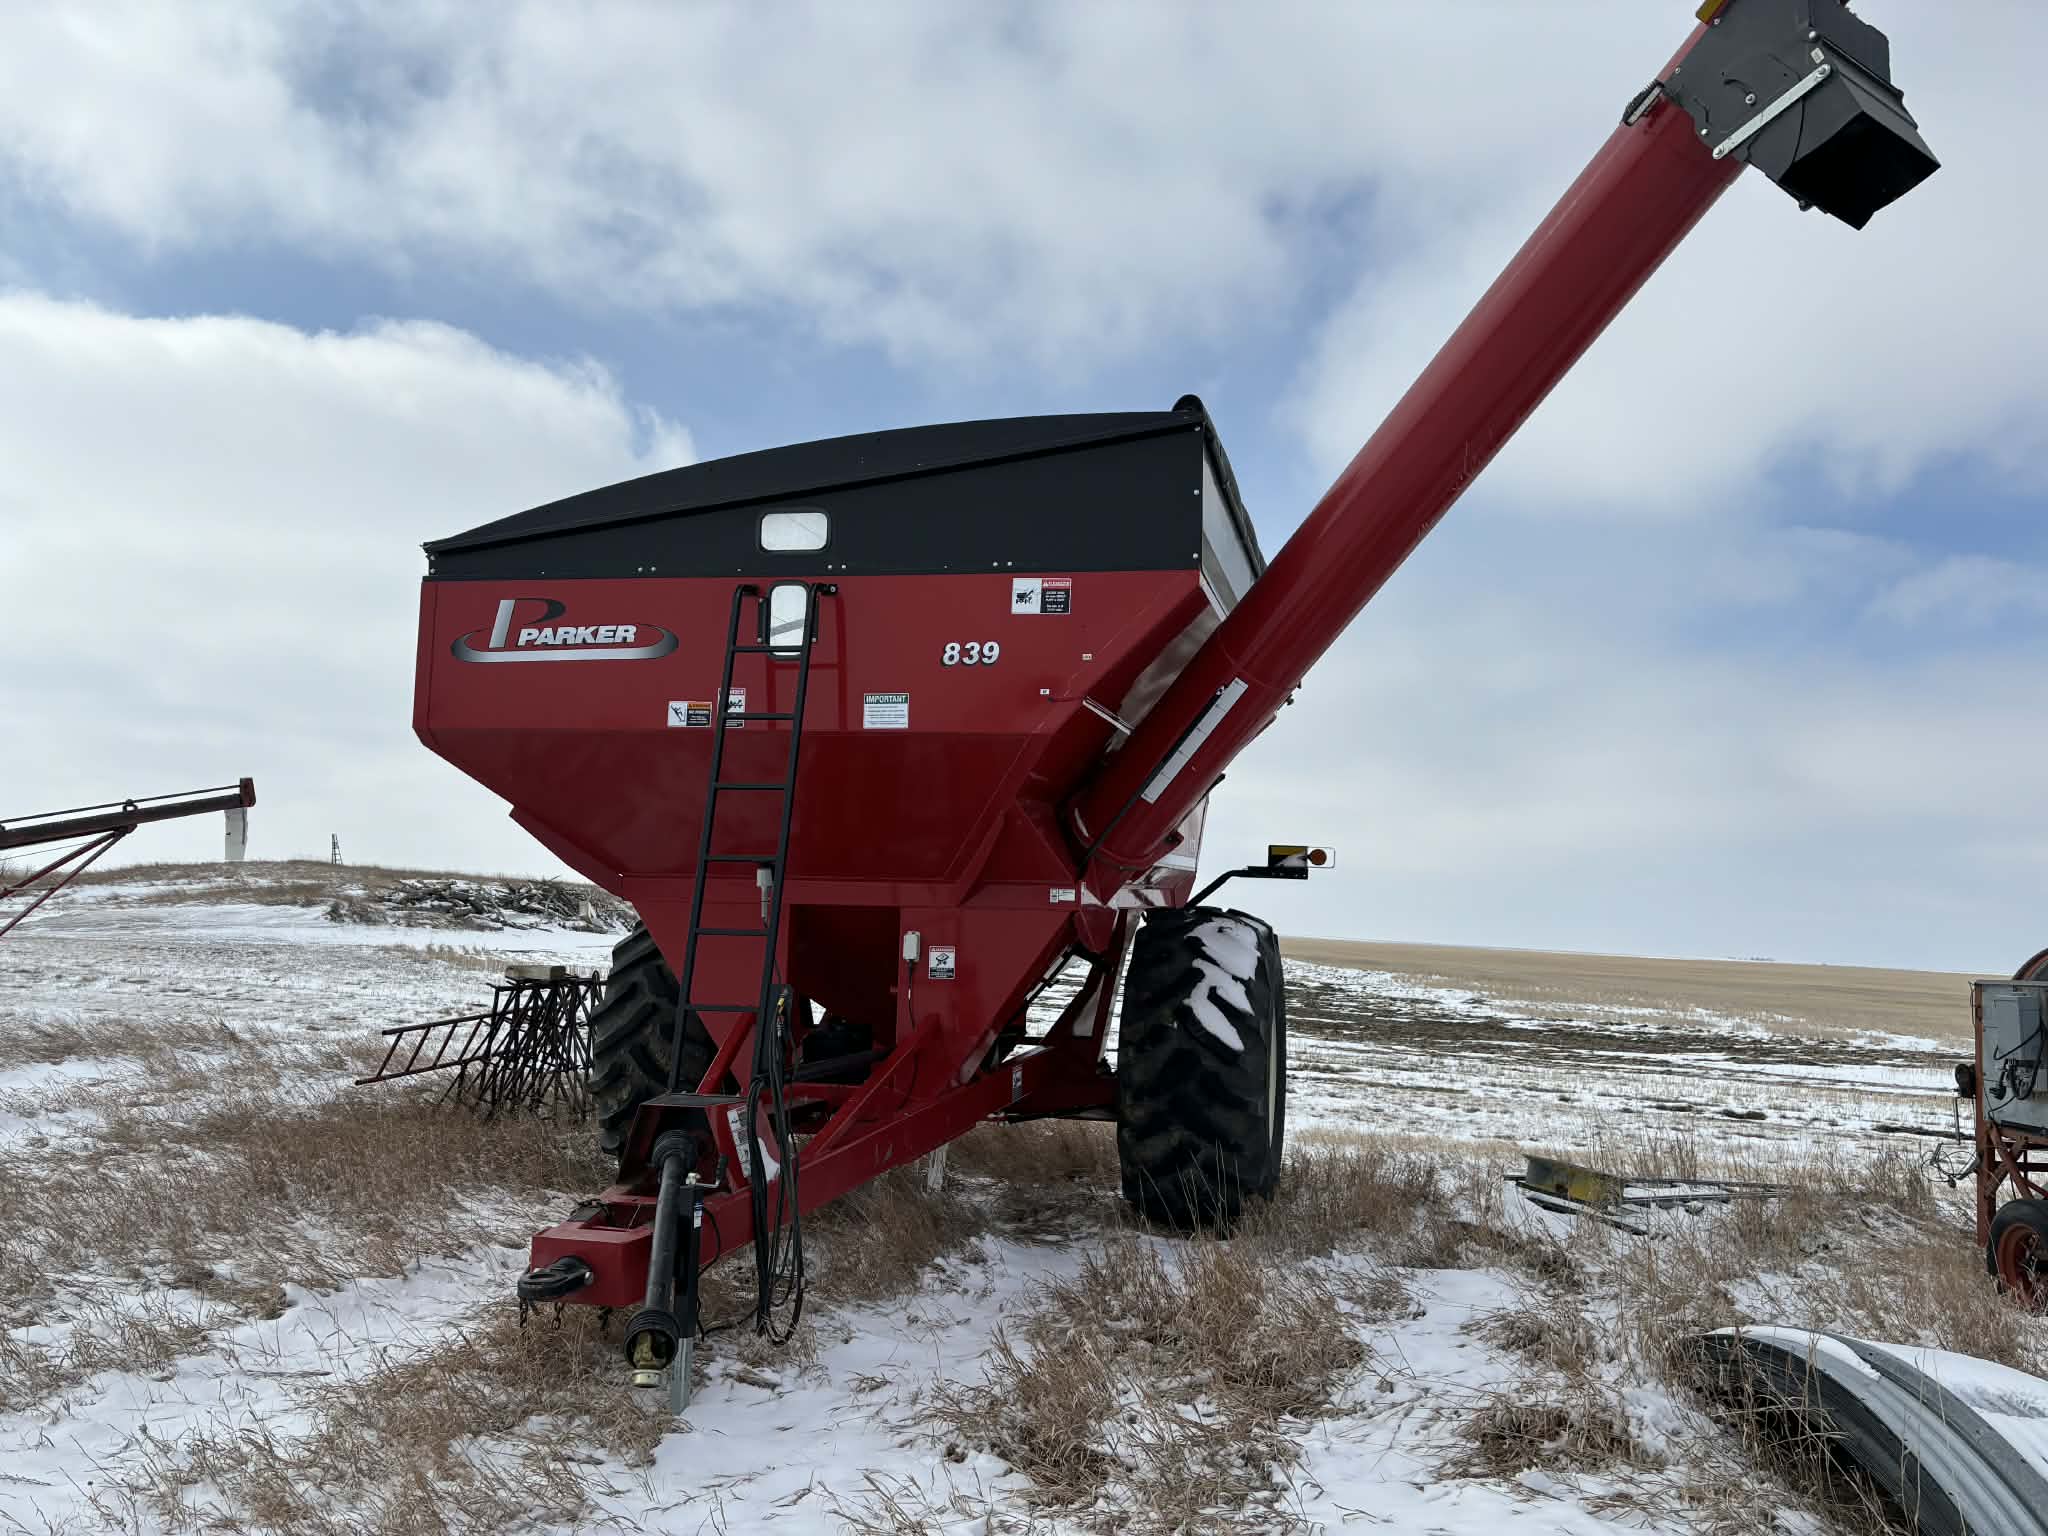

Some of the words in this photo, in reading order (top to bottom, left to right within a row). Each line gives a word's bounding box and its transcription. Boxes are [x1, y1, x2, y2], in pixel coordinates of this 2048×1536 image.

[516, 625, 637, 647] PARKER
[942, 641, 1000, 666] 839
[866, 695, 906, 703] IMPORTANT
